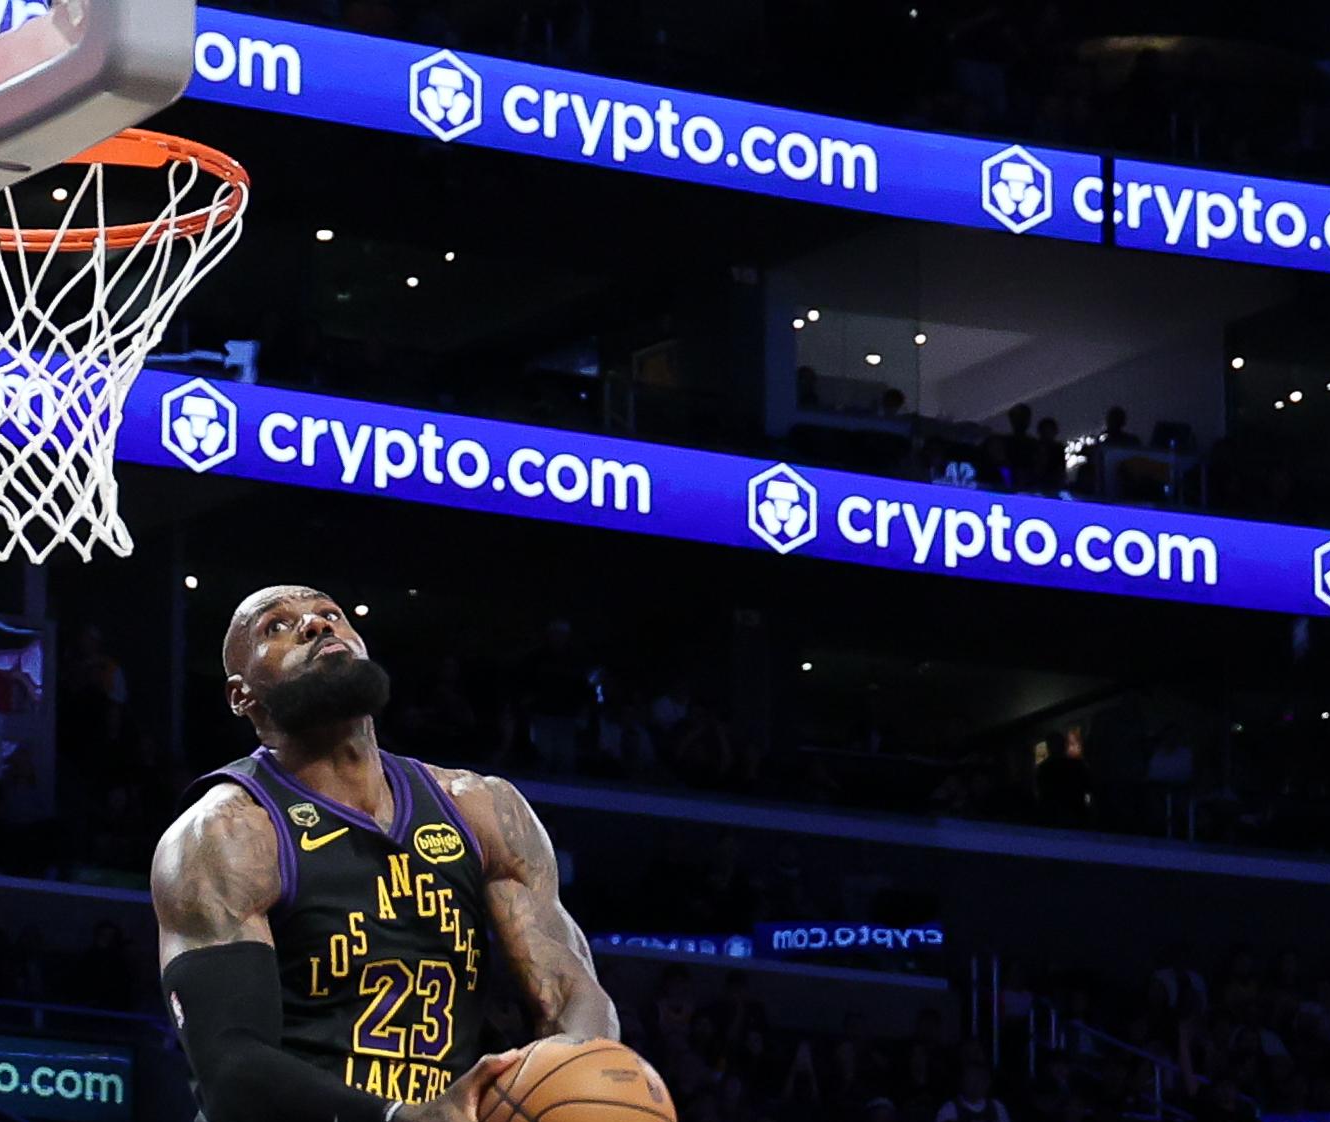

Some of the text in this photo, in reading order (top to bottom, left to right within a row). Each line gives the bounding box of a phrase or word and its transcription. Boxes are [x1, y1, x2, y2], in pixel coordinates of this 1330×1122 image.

[502, 84, 878, 193] crypto.com
[258, 411, 652, 515] crypto.com
[836, 495, 1218, 586] crypto.com
[310, 911, 368, 997] LOS
[353, 958, 457, 1062] 23
